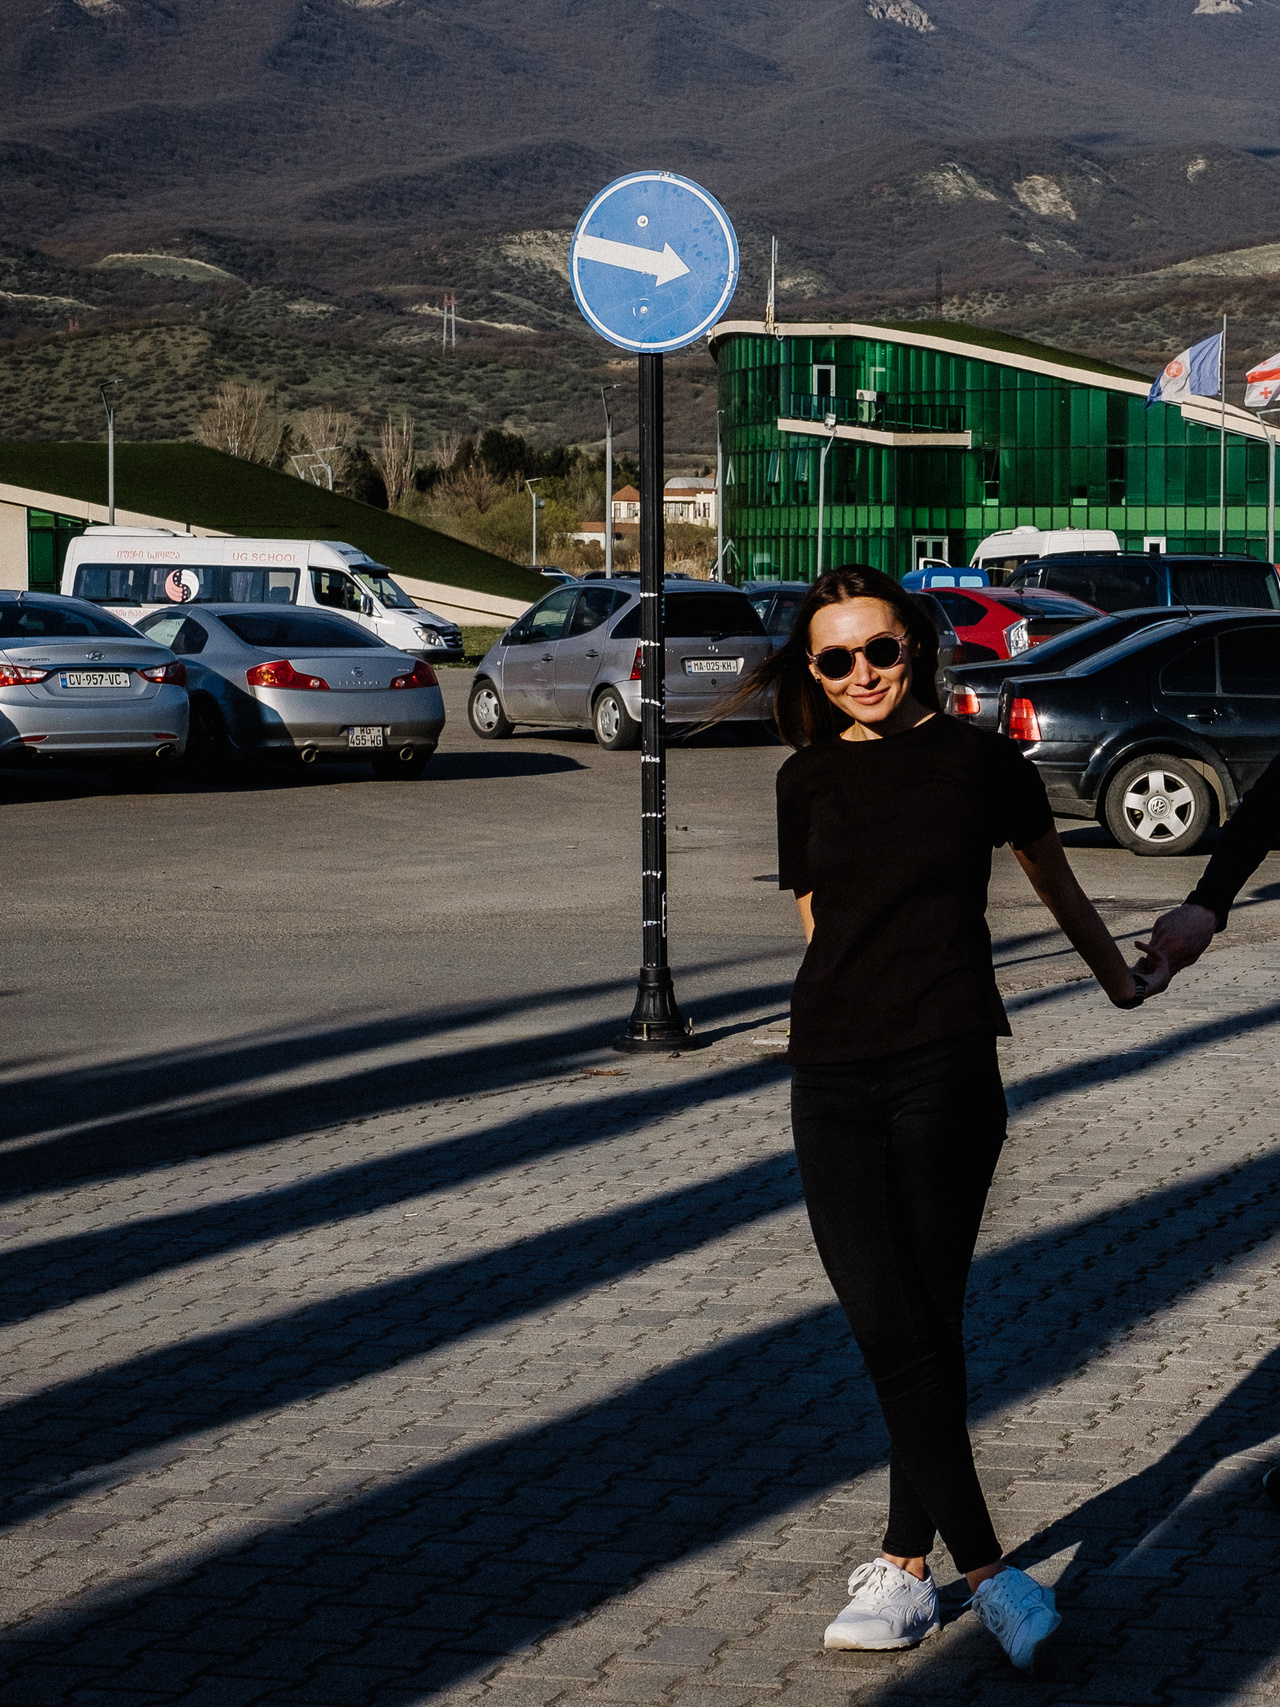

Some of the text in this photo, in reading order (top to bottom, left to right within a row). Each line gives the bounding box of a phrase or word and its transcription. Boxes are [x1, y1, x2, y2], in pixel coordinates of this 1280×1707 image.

[232, 552, 298, 562] UG SCHOOL
[68, 674, 122, 686] CV-957-VC
